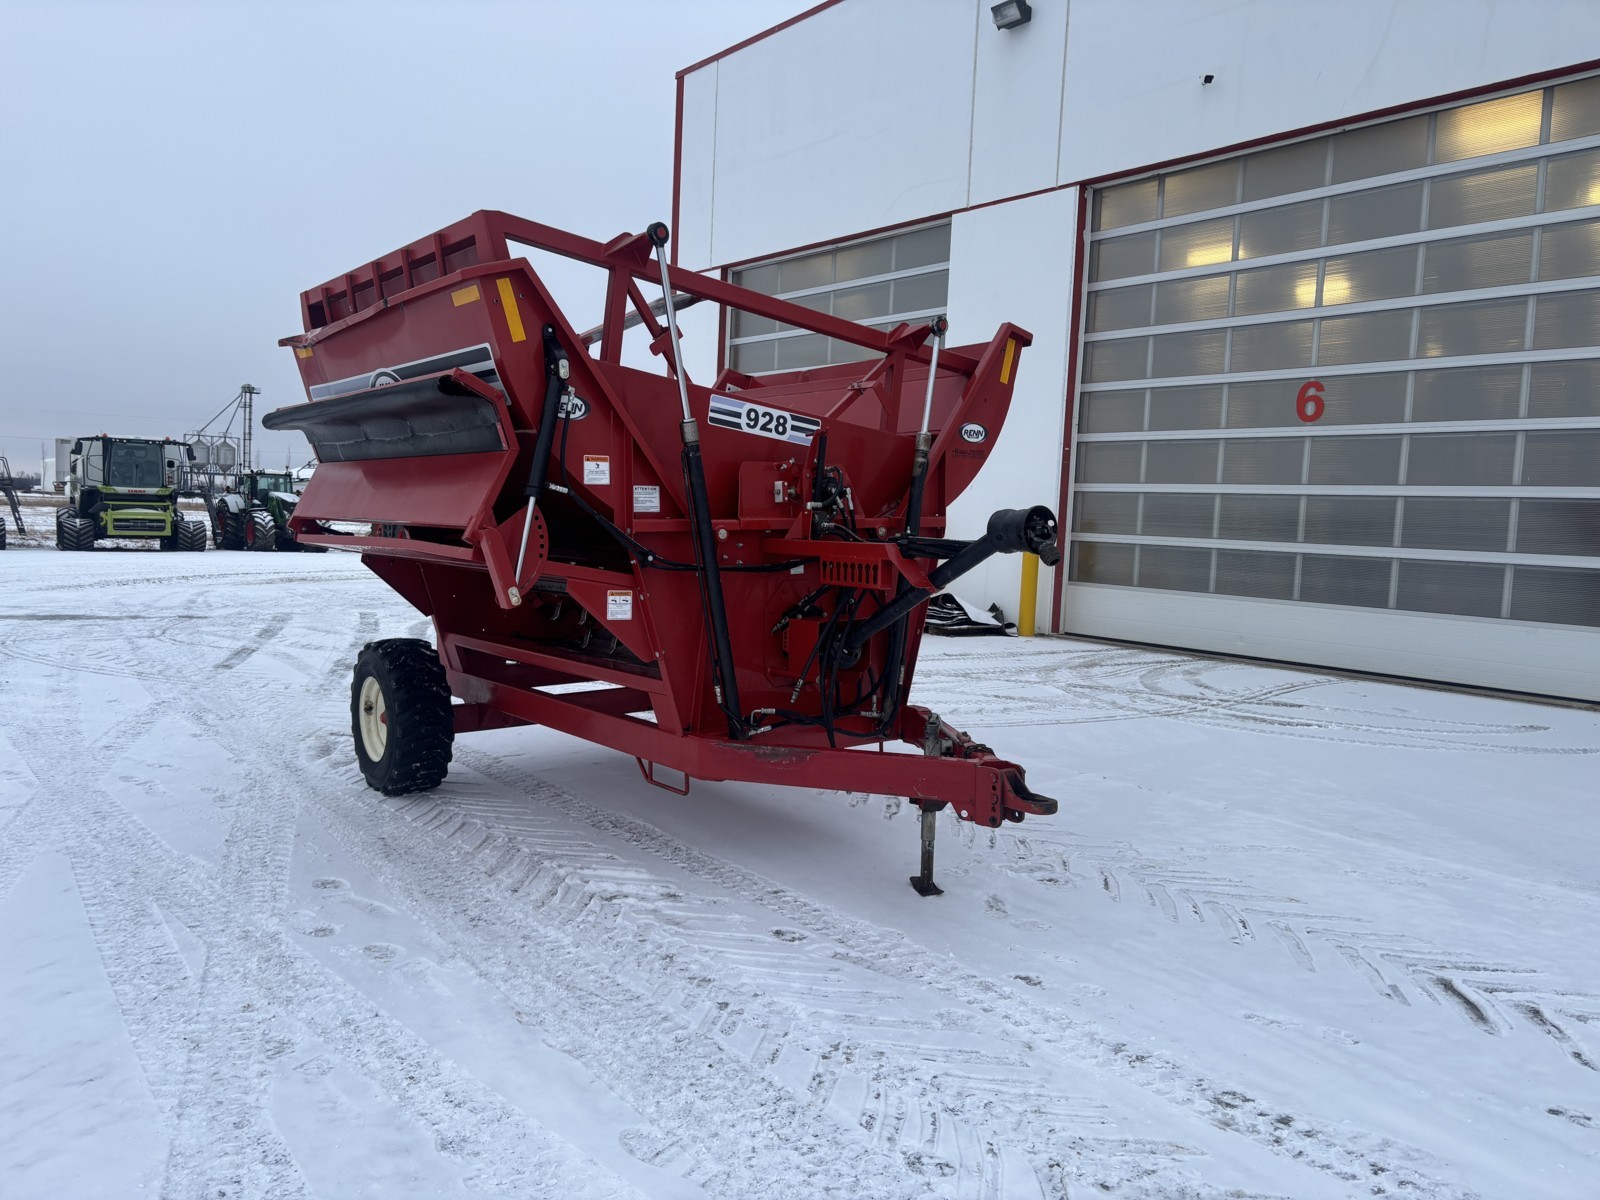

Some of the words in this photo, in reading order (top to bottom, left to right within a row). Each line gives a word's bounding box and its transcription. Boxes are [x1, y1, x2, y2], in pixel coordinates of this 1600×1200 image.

[1296, 381, 1325, 423] 6
[745, 408, 788, 436] 928
[963, 429, 984, 439] RENN
